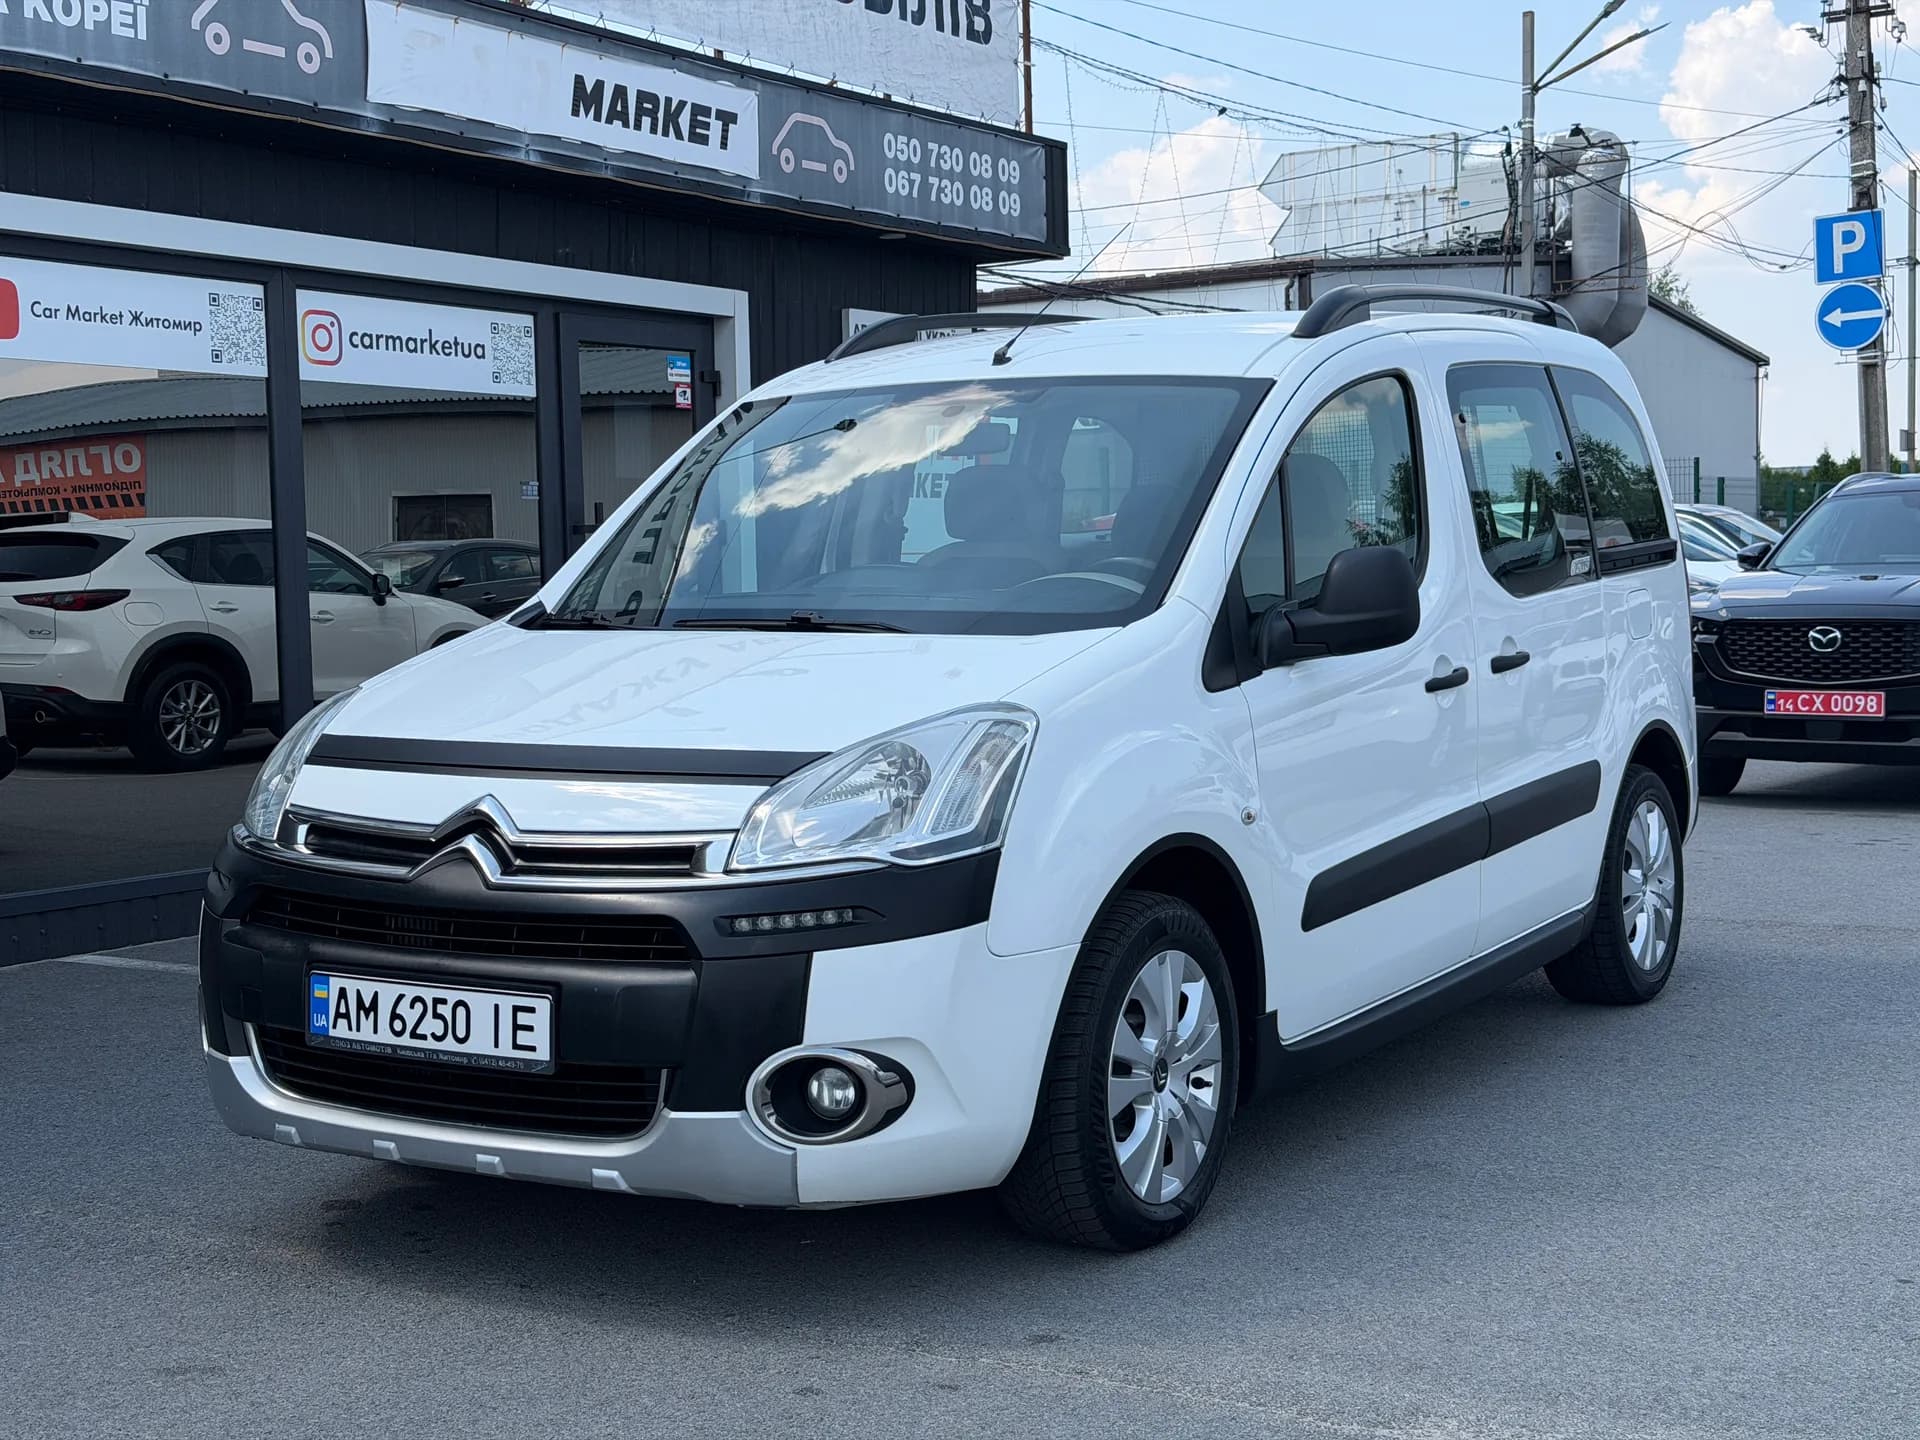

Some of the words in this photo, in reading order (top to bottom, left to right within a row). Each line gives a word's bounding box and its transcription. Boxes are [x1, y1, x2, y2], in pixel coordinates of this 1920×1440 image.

[570, 73, 739, 151] MARKET
[883, 132, 921, 164] 050
[927, 142, 963, 173] 730
[969, 151, 993, 179] 08
[998, 157, 1020, 185] 09
[884, 167, 921, 198] 067
[928, 176, 964, 206] 730
[970, 184, 993, 212] 08
[998, 190, 1021, 217] 09
[1832, 220, 1866, 274] P
[30, 300, 60, 320] Car
[65, 303, 124, 326] Market
[127, 309, 203, 336] Житомир
[348, 328, 486, 360] carmarketua
[1777, 698, 1793, 712] 14
[1797, 694, 1825, 712] CX
[1831, 695, 1877, 713] 0098
[313, 1013, 328, 1028] UA
[332, 986, 379, 1035] AM
[389, 993, 471, 1045] 6250
[493, 1003, 537, 1053] IE
